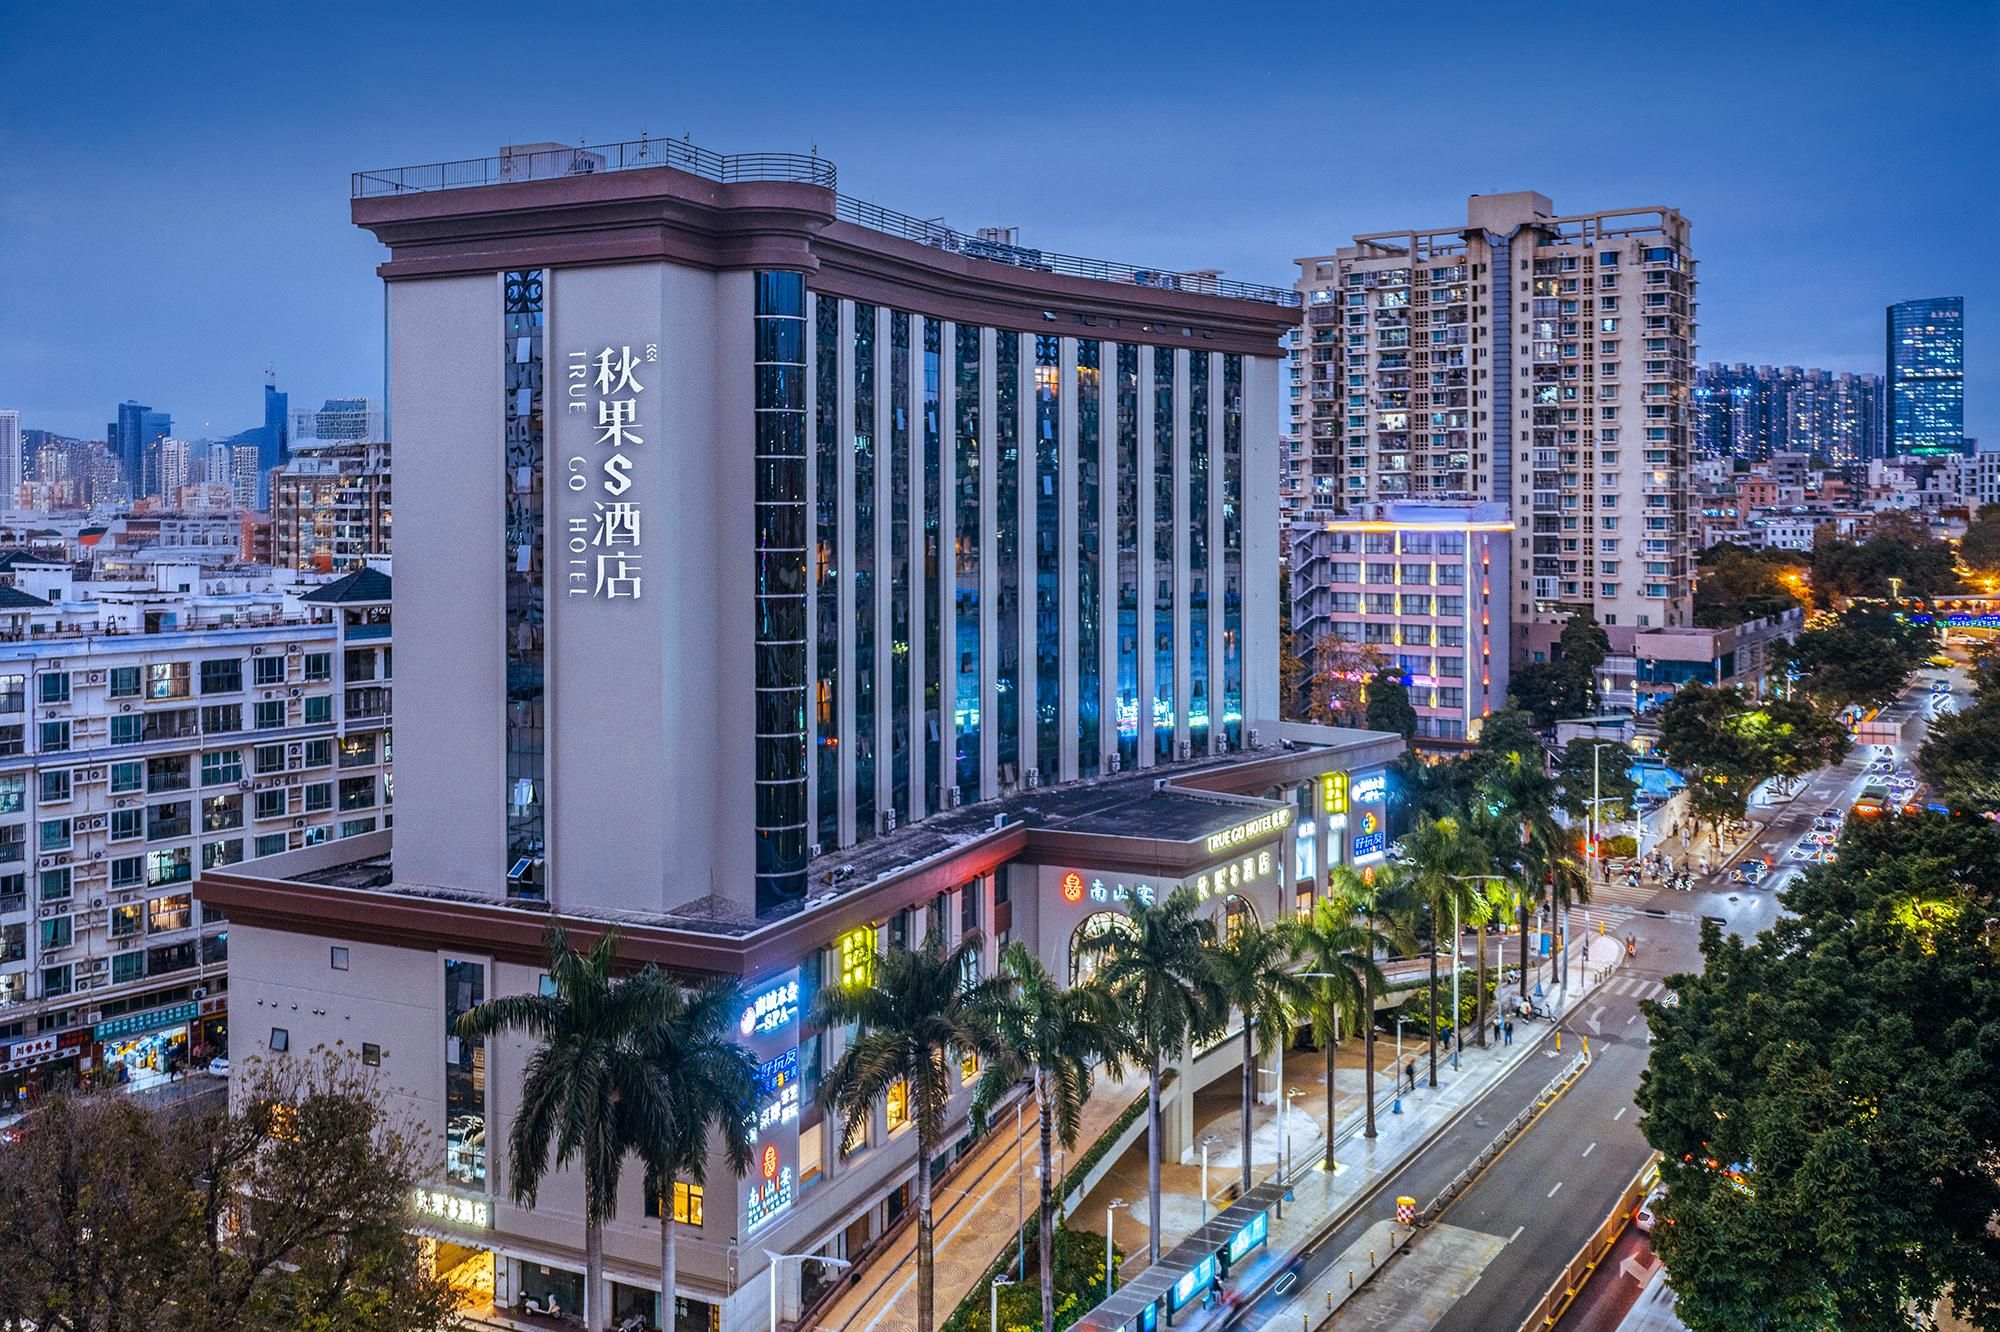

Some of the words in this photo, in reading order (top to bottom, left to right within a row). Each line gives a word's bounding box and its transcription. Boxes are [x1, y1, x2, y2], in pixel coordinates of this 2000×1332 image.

[568, 350, 587, 414] TRUE
[568, 456, 587, 491] GO
[592, 346, 644, 599] 秋果S酒店
[568, 518, 588, 597] HOTEL
[1208, 831, 1232, 853] TRUE
[1231, 826, 1246, 843] GO
[1246, 816, 1272, 838] HOTEL
[1355, 833, 1382, 850] 好玩友
[764, 1005, 790, 1030] SPA
